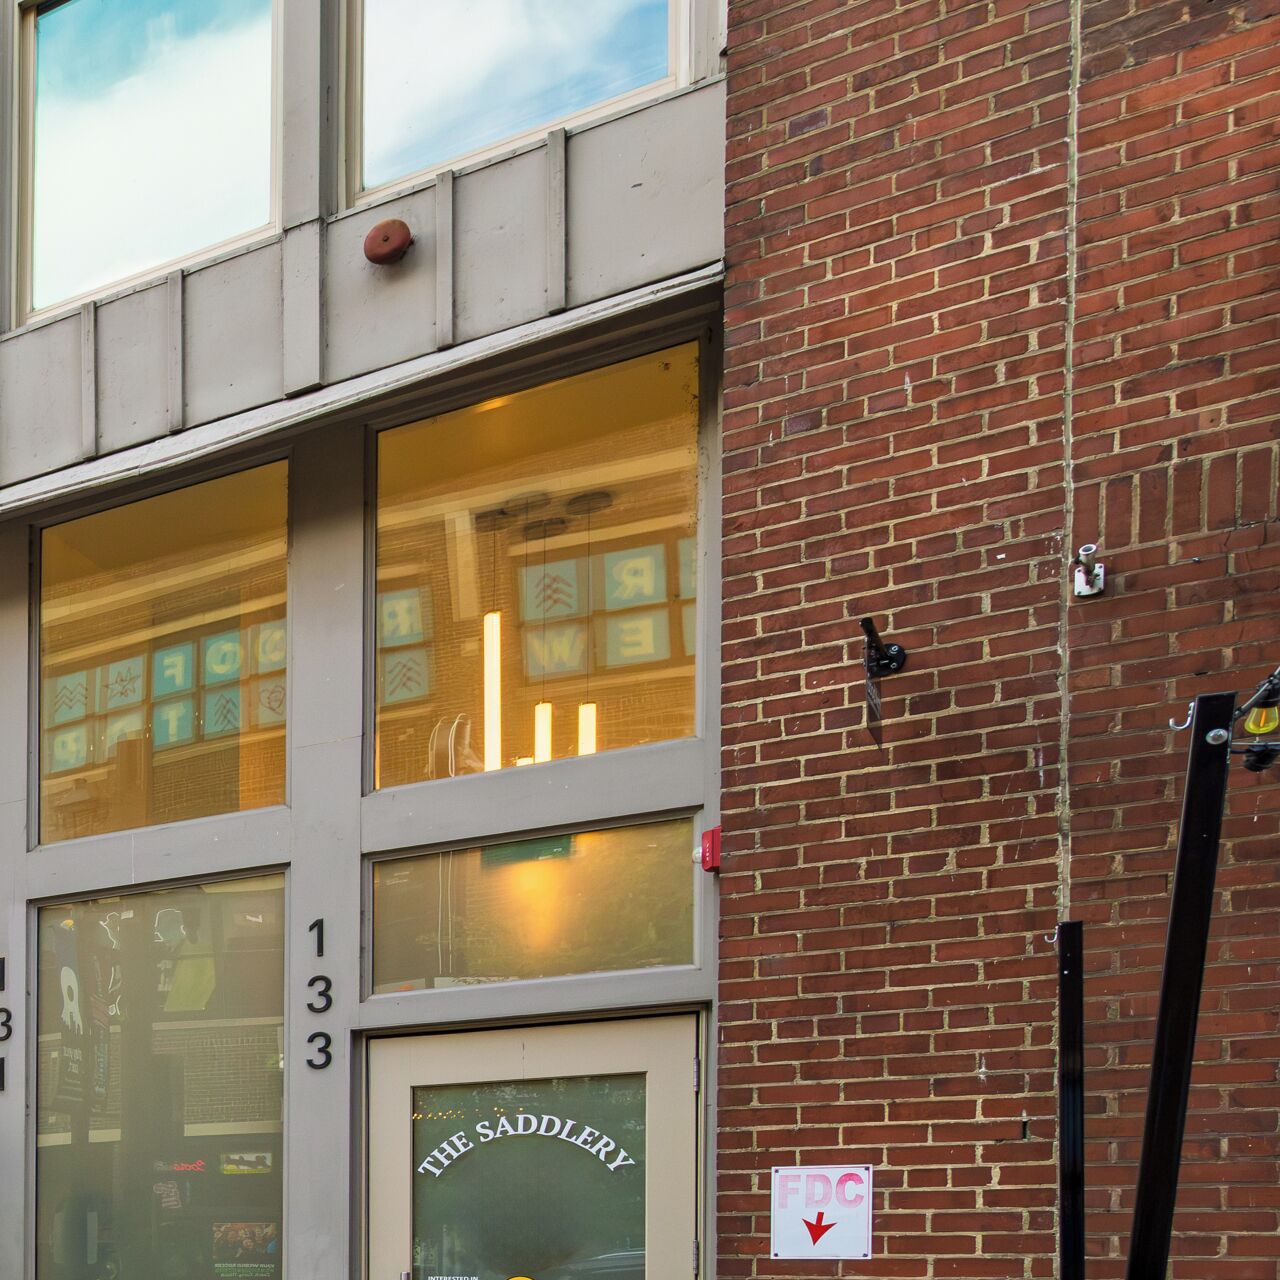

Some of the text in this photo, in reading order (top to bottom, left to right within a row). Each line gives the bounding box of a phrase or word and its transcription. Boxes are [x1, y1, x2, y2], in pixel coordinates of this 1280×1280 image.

[417, 1114, 636, 1178] THE SADDLERY
[778, 1172, 864, 1209] FDC
